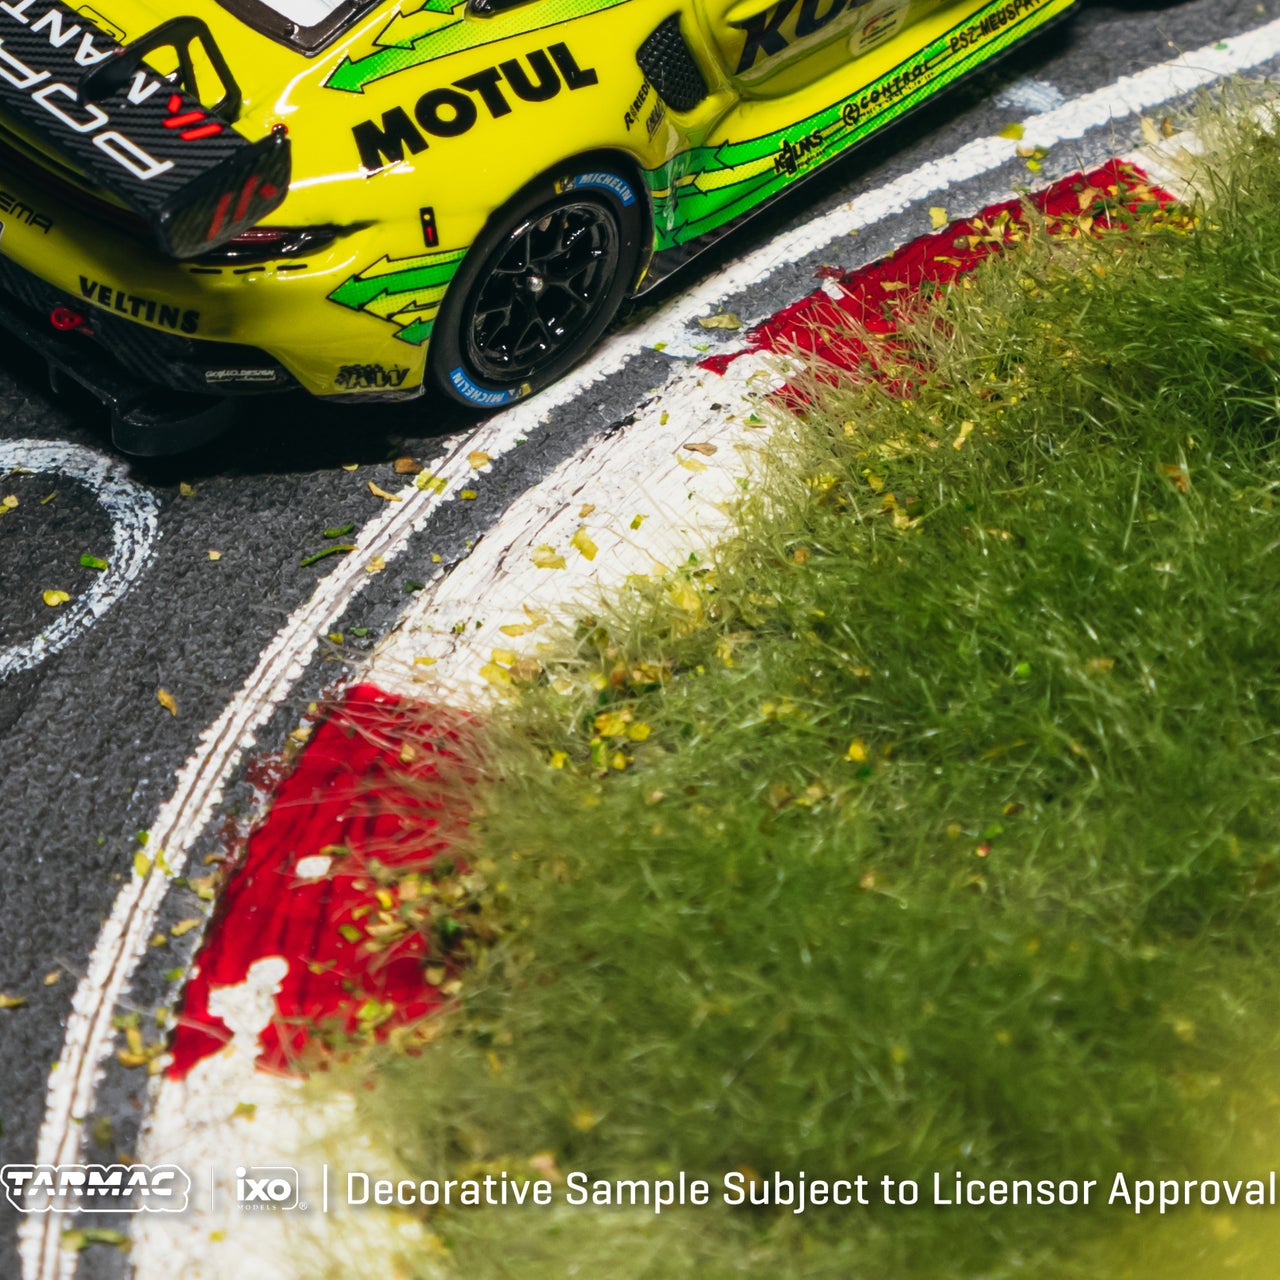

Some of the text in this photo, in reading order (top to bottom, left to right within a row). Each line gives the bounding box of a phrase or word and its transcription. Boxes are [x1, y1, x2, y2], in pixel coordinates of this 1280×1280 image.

[351, 41, 599, 179] MOTUL
[580, 172, 633, 202] MICHELIN
[78, 275, 201, 335] VELTINS
[451, 370, 506, 407] MICHELIN
